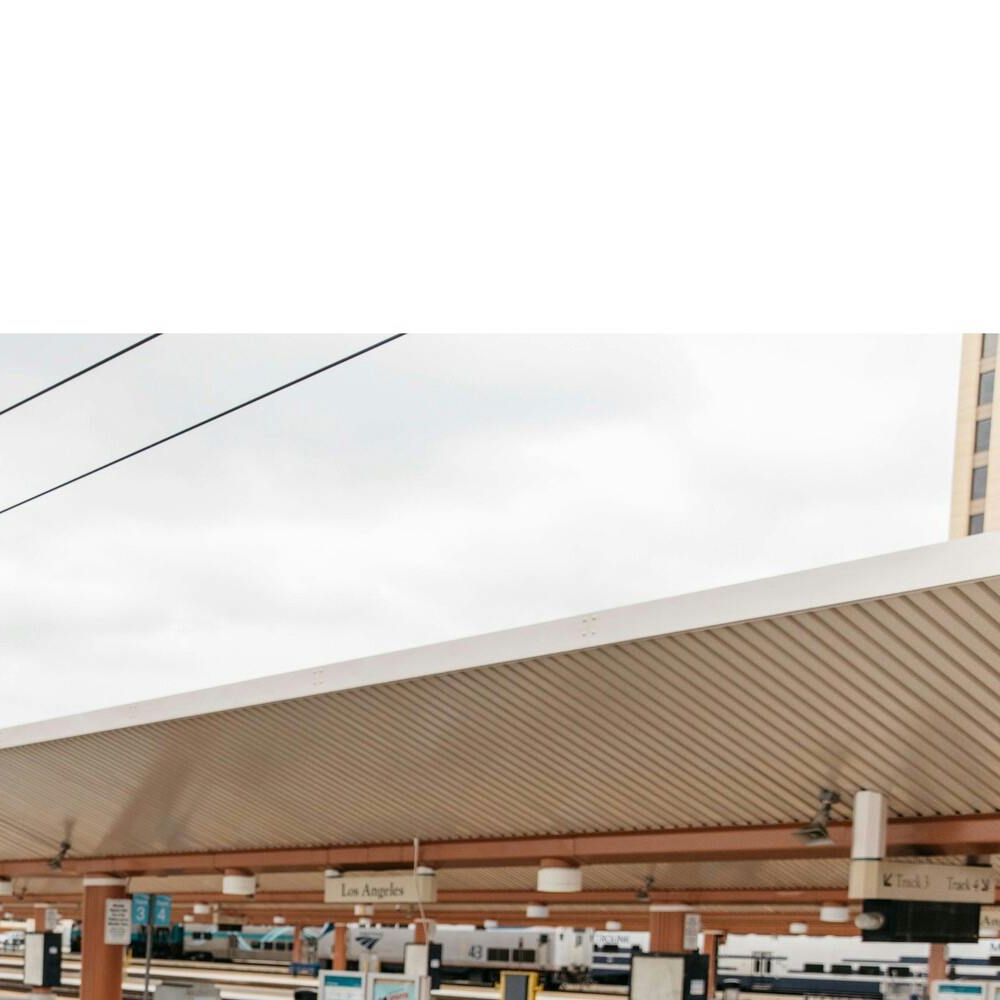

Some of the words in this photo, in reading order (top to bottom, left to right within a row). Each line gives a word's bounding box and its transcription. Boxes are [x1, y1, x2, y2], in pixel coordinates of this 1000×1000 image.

[341, 883, 359, 897] Los
[361, 883, 405, 898] Angeles
[135, 906, 146, 921] 3
[157, 907, 167, 921] 4
